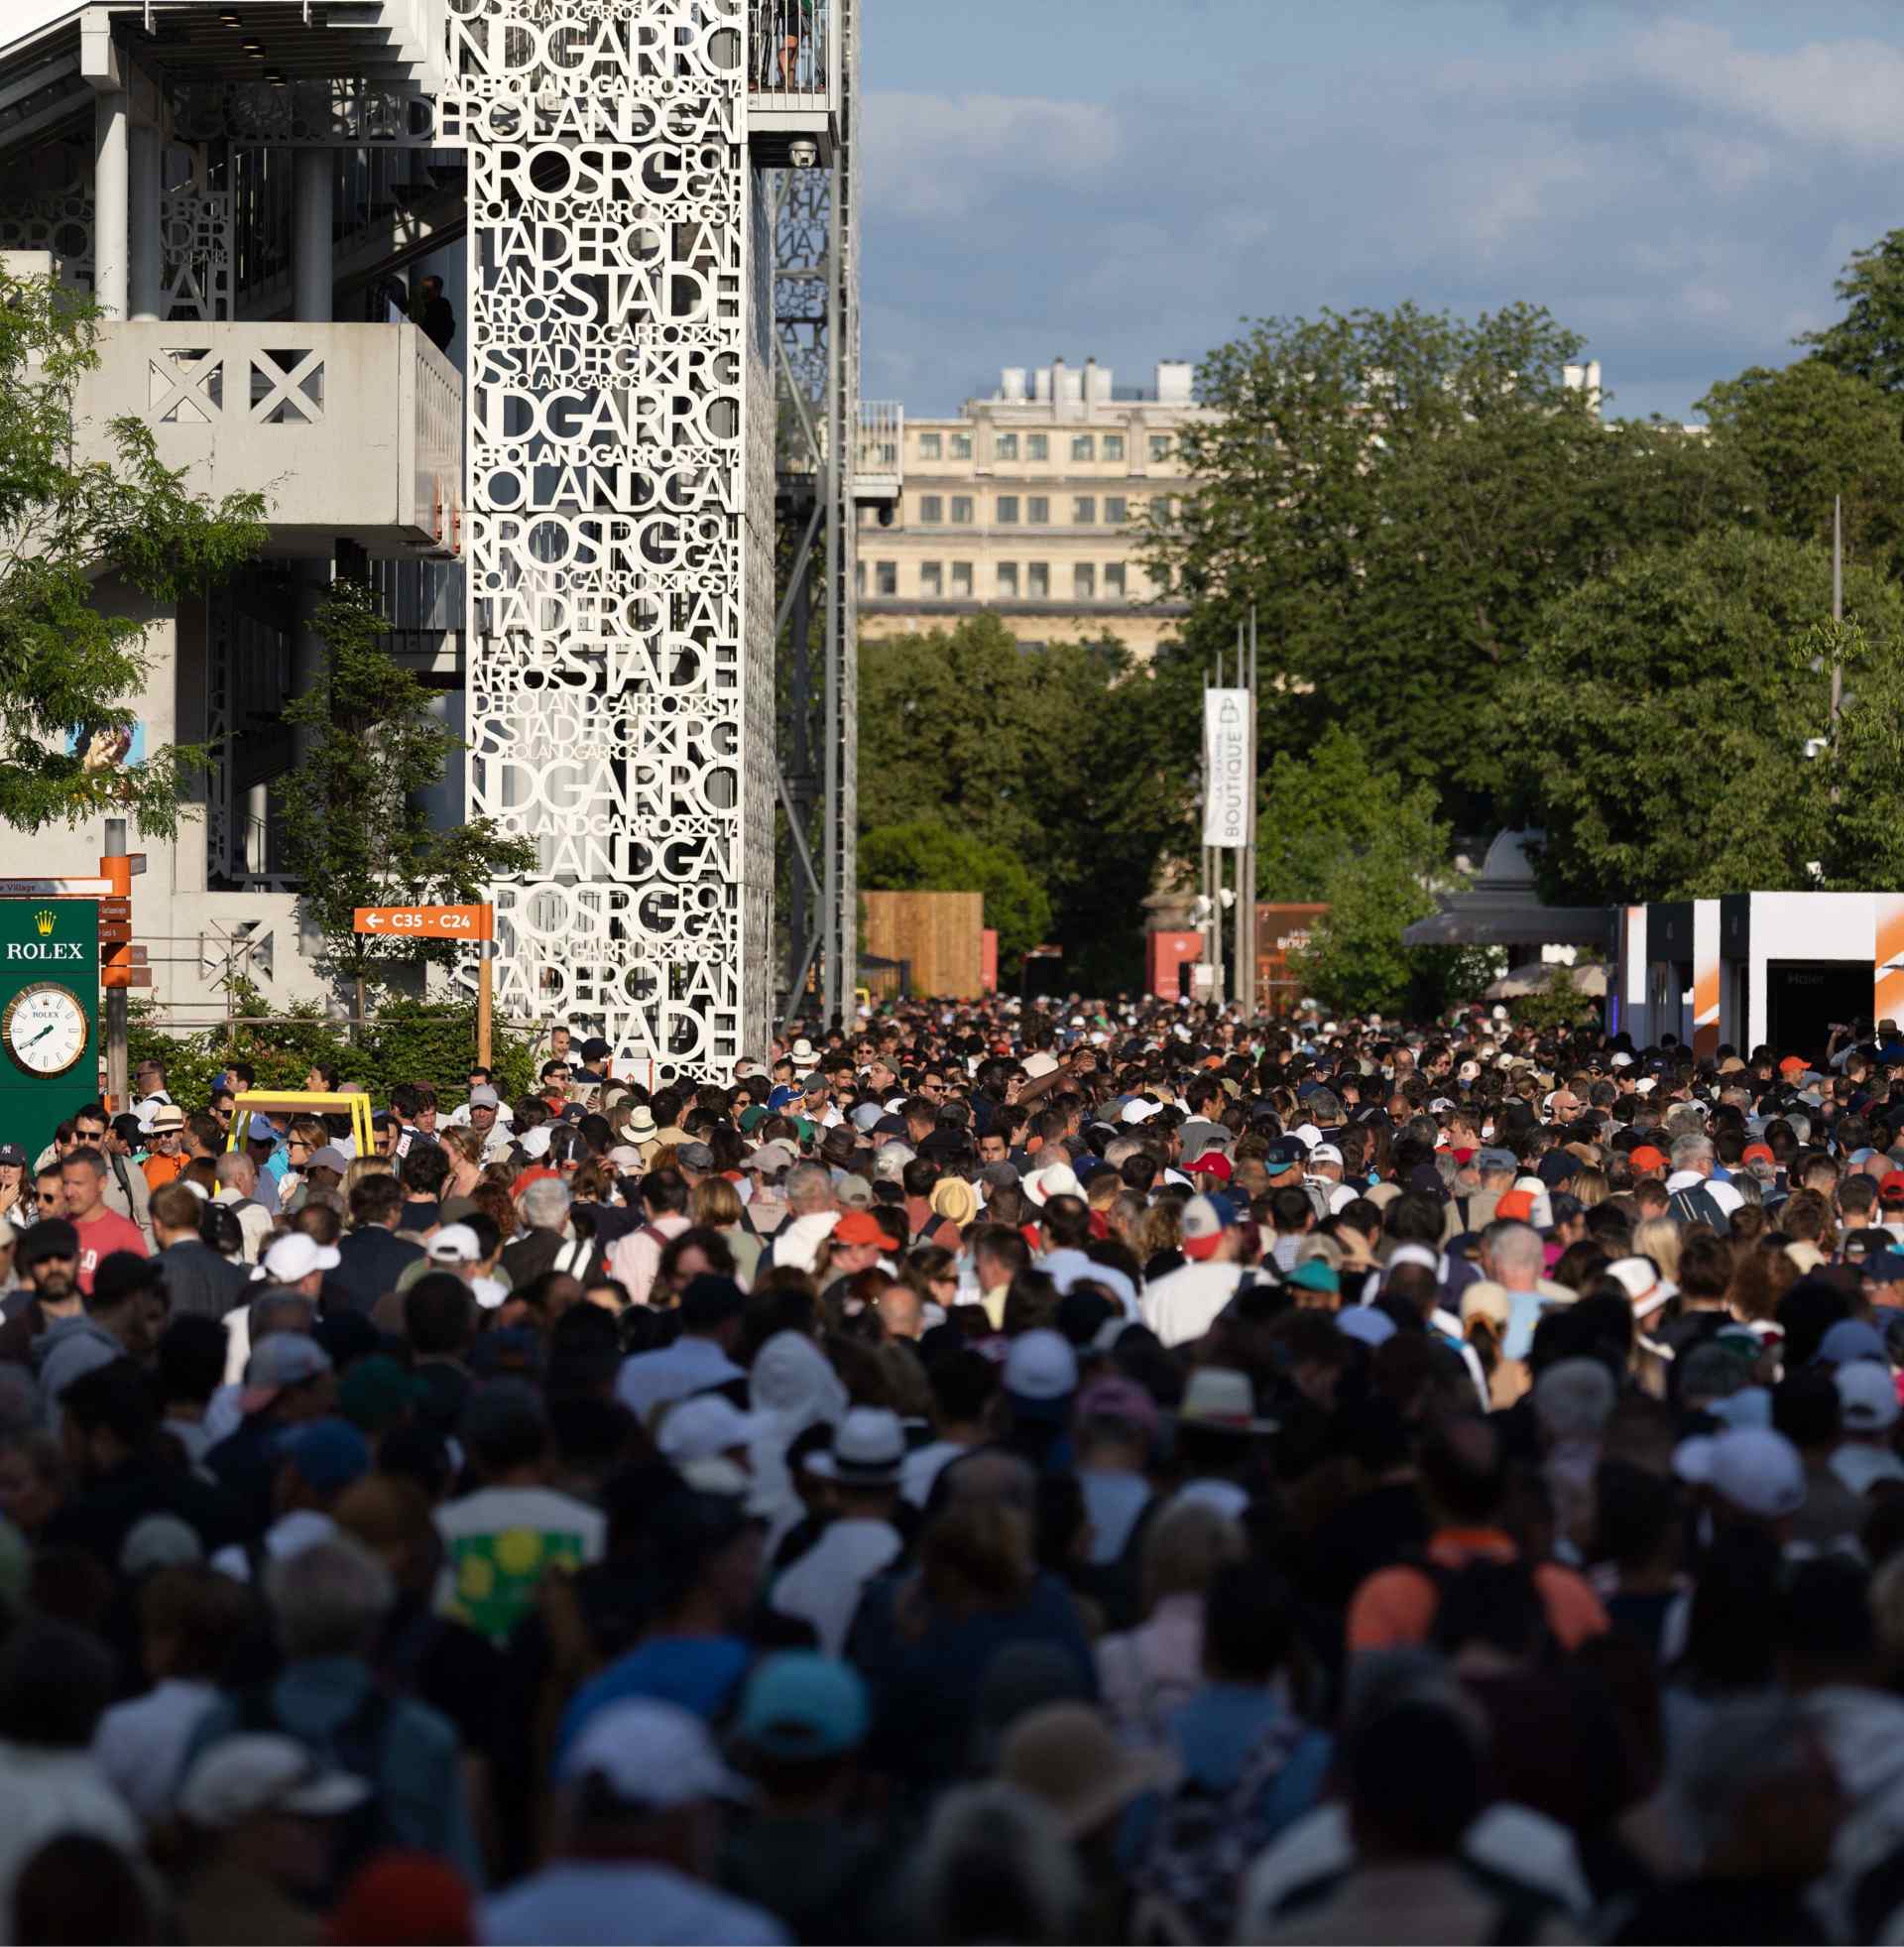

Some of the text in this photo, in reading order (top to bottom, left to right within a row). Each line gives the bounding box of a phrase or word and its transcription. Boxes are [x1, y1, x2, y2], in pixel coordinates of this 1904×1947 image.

[1224, 730, 1243, 838] BOUTIQUE
[392, 913, 422, 927] C35
[439, 914, 471, 928] C24
[6, 943, 84, 960] ROLEX
